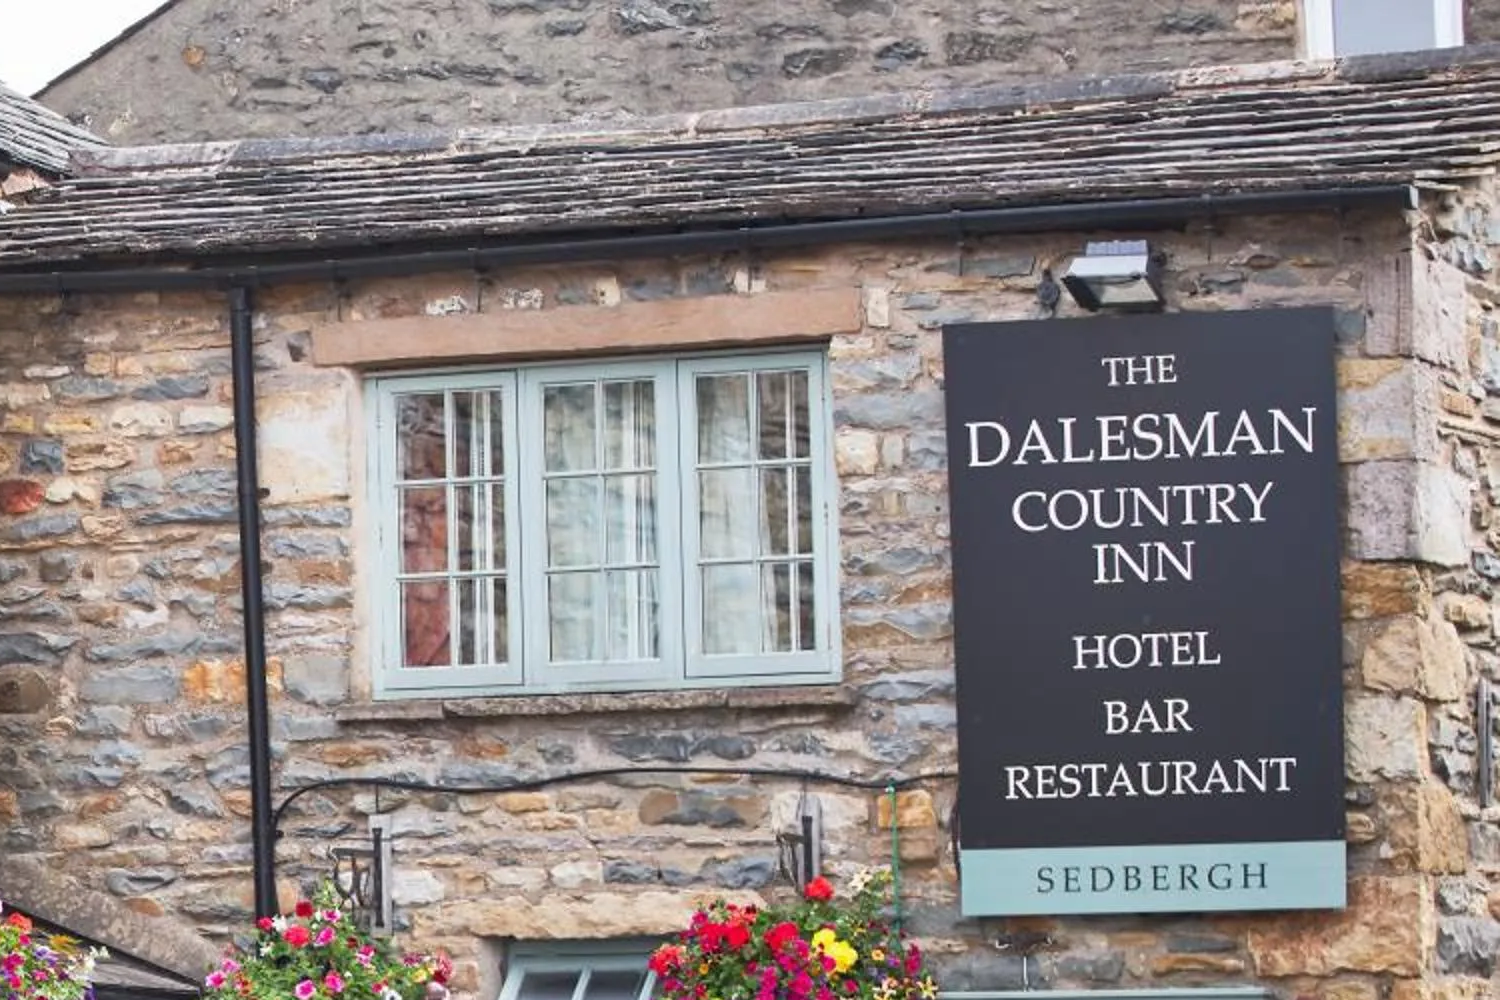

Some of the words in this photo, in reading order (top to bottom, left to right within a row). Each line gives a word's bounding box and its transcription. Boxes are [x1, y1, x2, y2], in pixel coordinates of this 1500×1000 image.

[1102, 355, 1177, 387] THE
[965, 407, 1317, 467] DALESMAN
[1011, 482, 1274, 532] COUNTRY
[1093, 541, 1195, 584] INN
[1073, 631, 1221, 670] HOTEL
[1103, 699, 1193, 735] BAR
[1005, 758, 1297, 799] RESTAURANT
[1037, 863, 1268, 893] SEDBERGH
